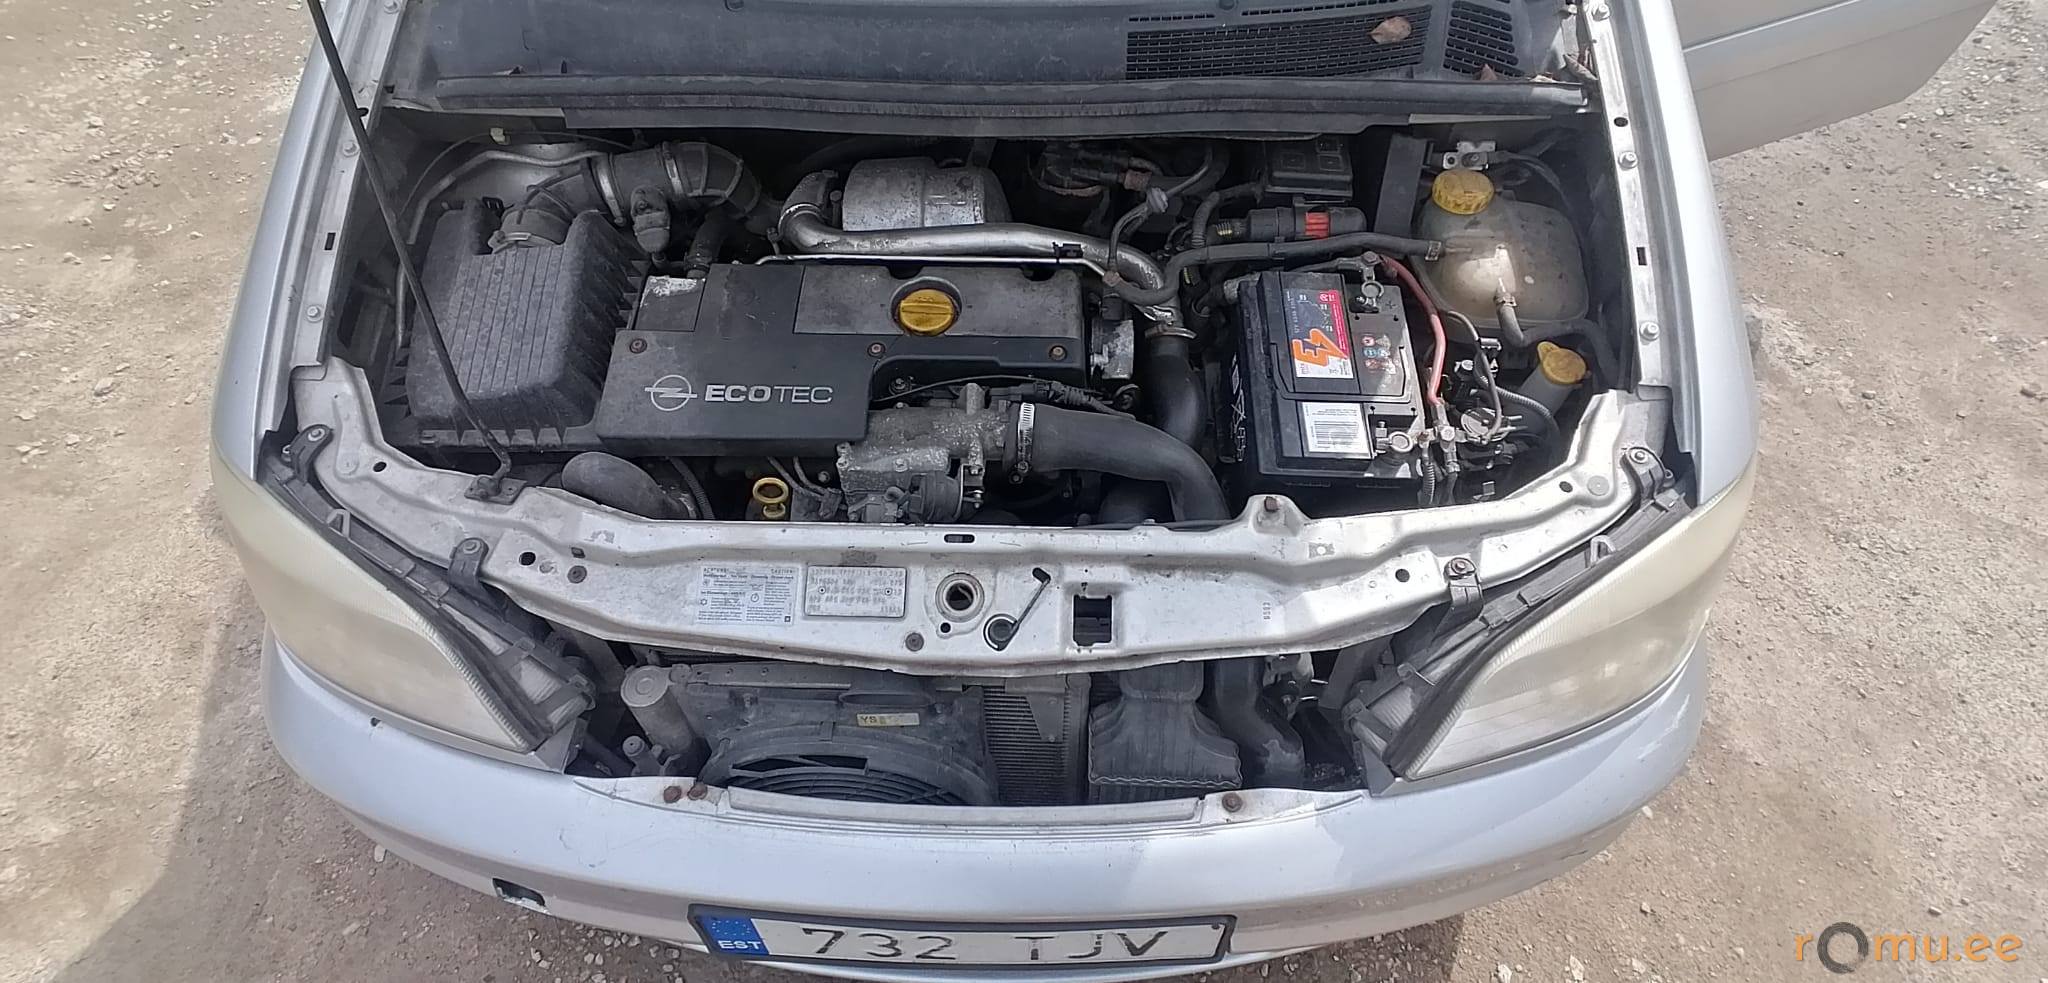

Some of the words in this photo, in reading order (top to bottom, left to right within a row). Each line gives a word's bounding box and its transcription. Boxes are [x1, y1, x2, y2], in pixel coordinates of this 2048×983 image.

[705, 384, 833, 403] ECOTEC
[717, 940, 761, 950] EST
[802, 927, 957, 961] 732
[1013, 930, 1169, 961] TJV
